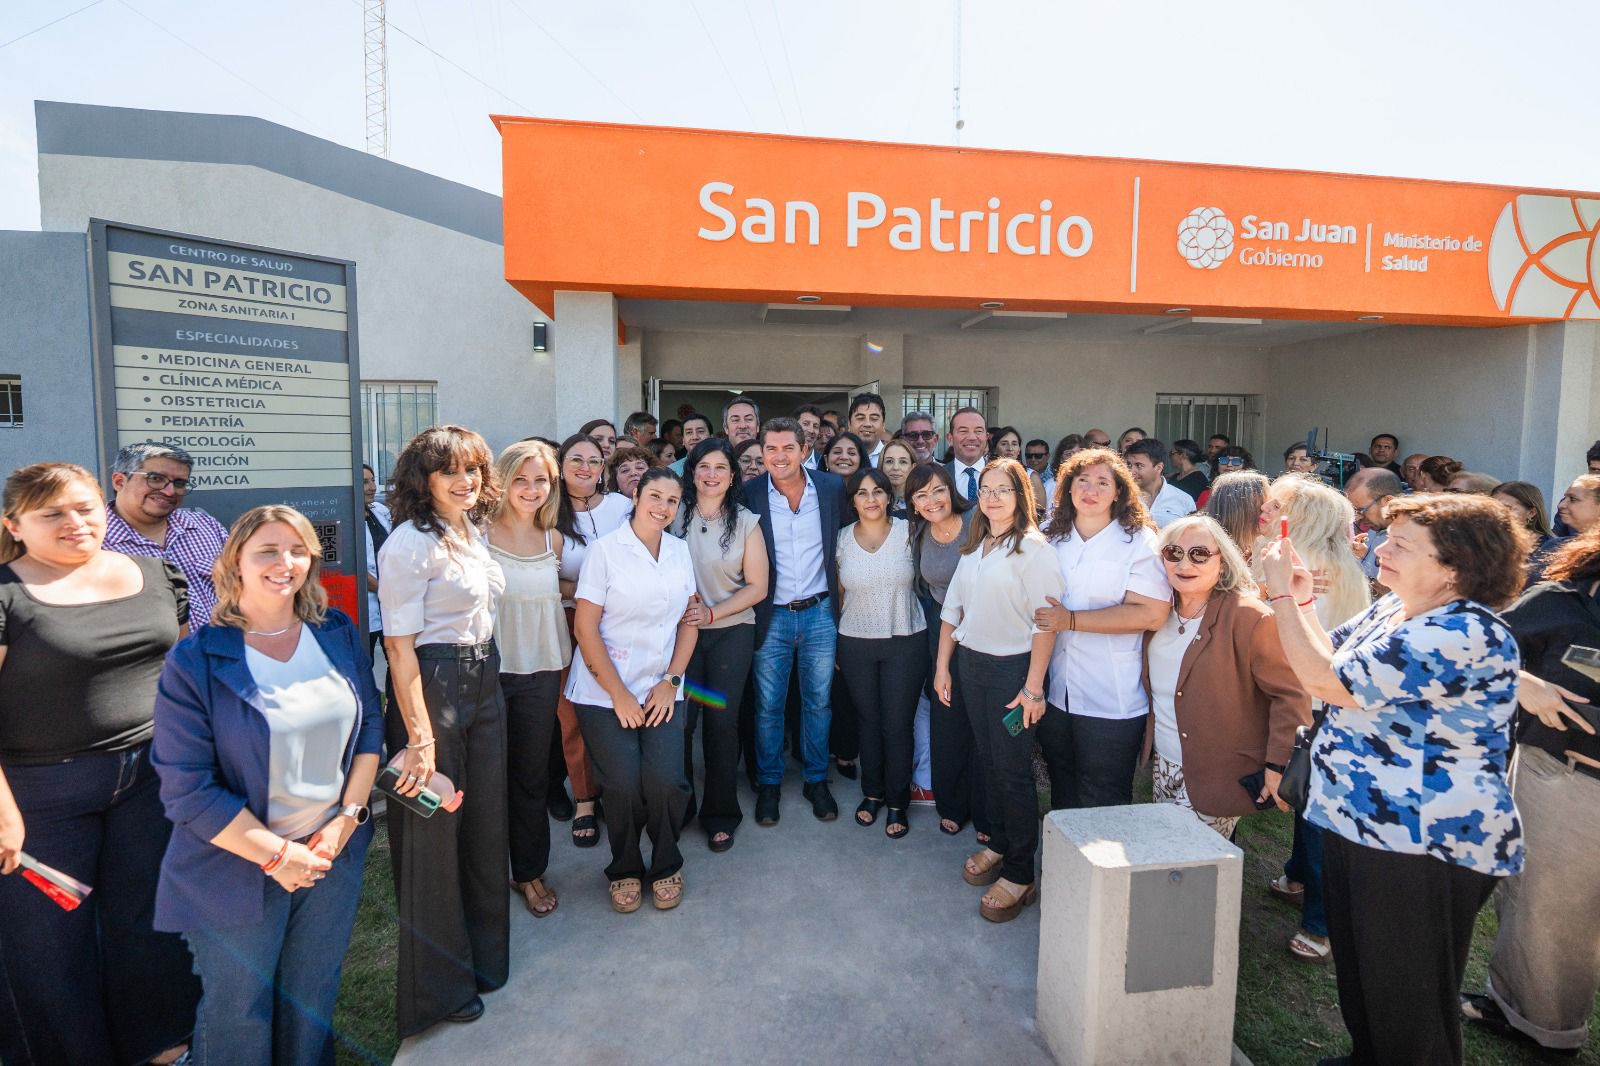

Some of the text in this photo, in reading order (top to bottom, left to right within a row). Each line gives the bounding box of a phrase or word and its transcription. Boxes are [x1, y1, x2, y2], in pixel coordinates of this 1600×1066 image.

[697, 181, 1094, 258] San Patricio
[1240, 214, 1357, 244] San Juan
[1383, 232, 1483, 252] Ministerio de
[169, 244, 294, 272] CENTRO DE SALUD
[1239, 246, 1324, 269] Gobierno
[1381, 254, 1428, 272] Salud
[128, 260, 332, 305] SAN PATRICIO
[178, 299, 218, 312] ZONA
[221, 304, 289, 320] SANITARIA
[176, 330, 299, 350] ESPECIALIDADES
[158, 353, 312, 374] MEDICINA GENERAL
[159, 373, 283, 391] CLÍNICA MÉDICA
[160, 395, 266, 409] OBSTETRICIA
[161, 414, 245, 428] PEDIATRÍA
[162, 434, 256, 447] PSICOLOGÍA
